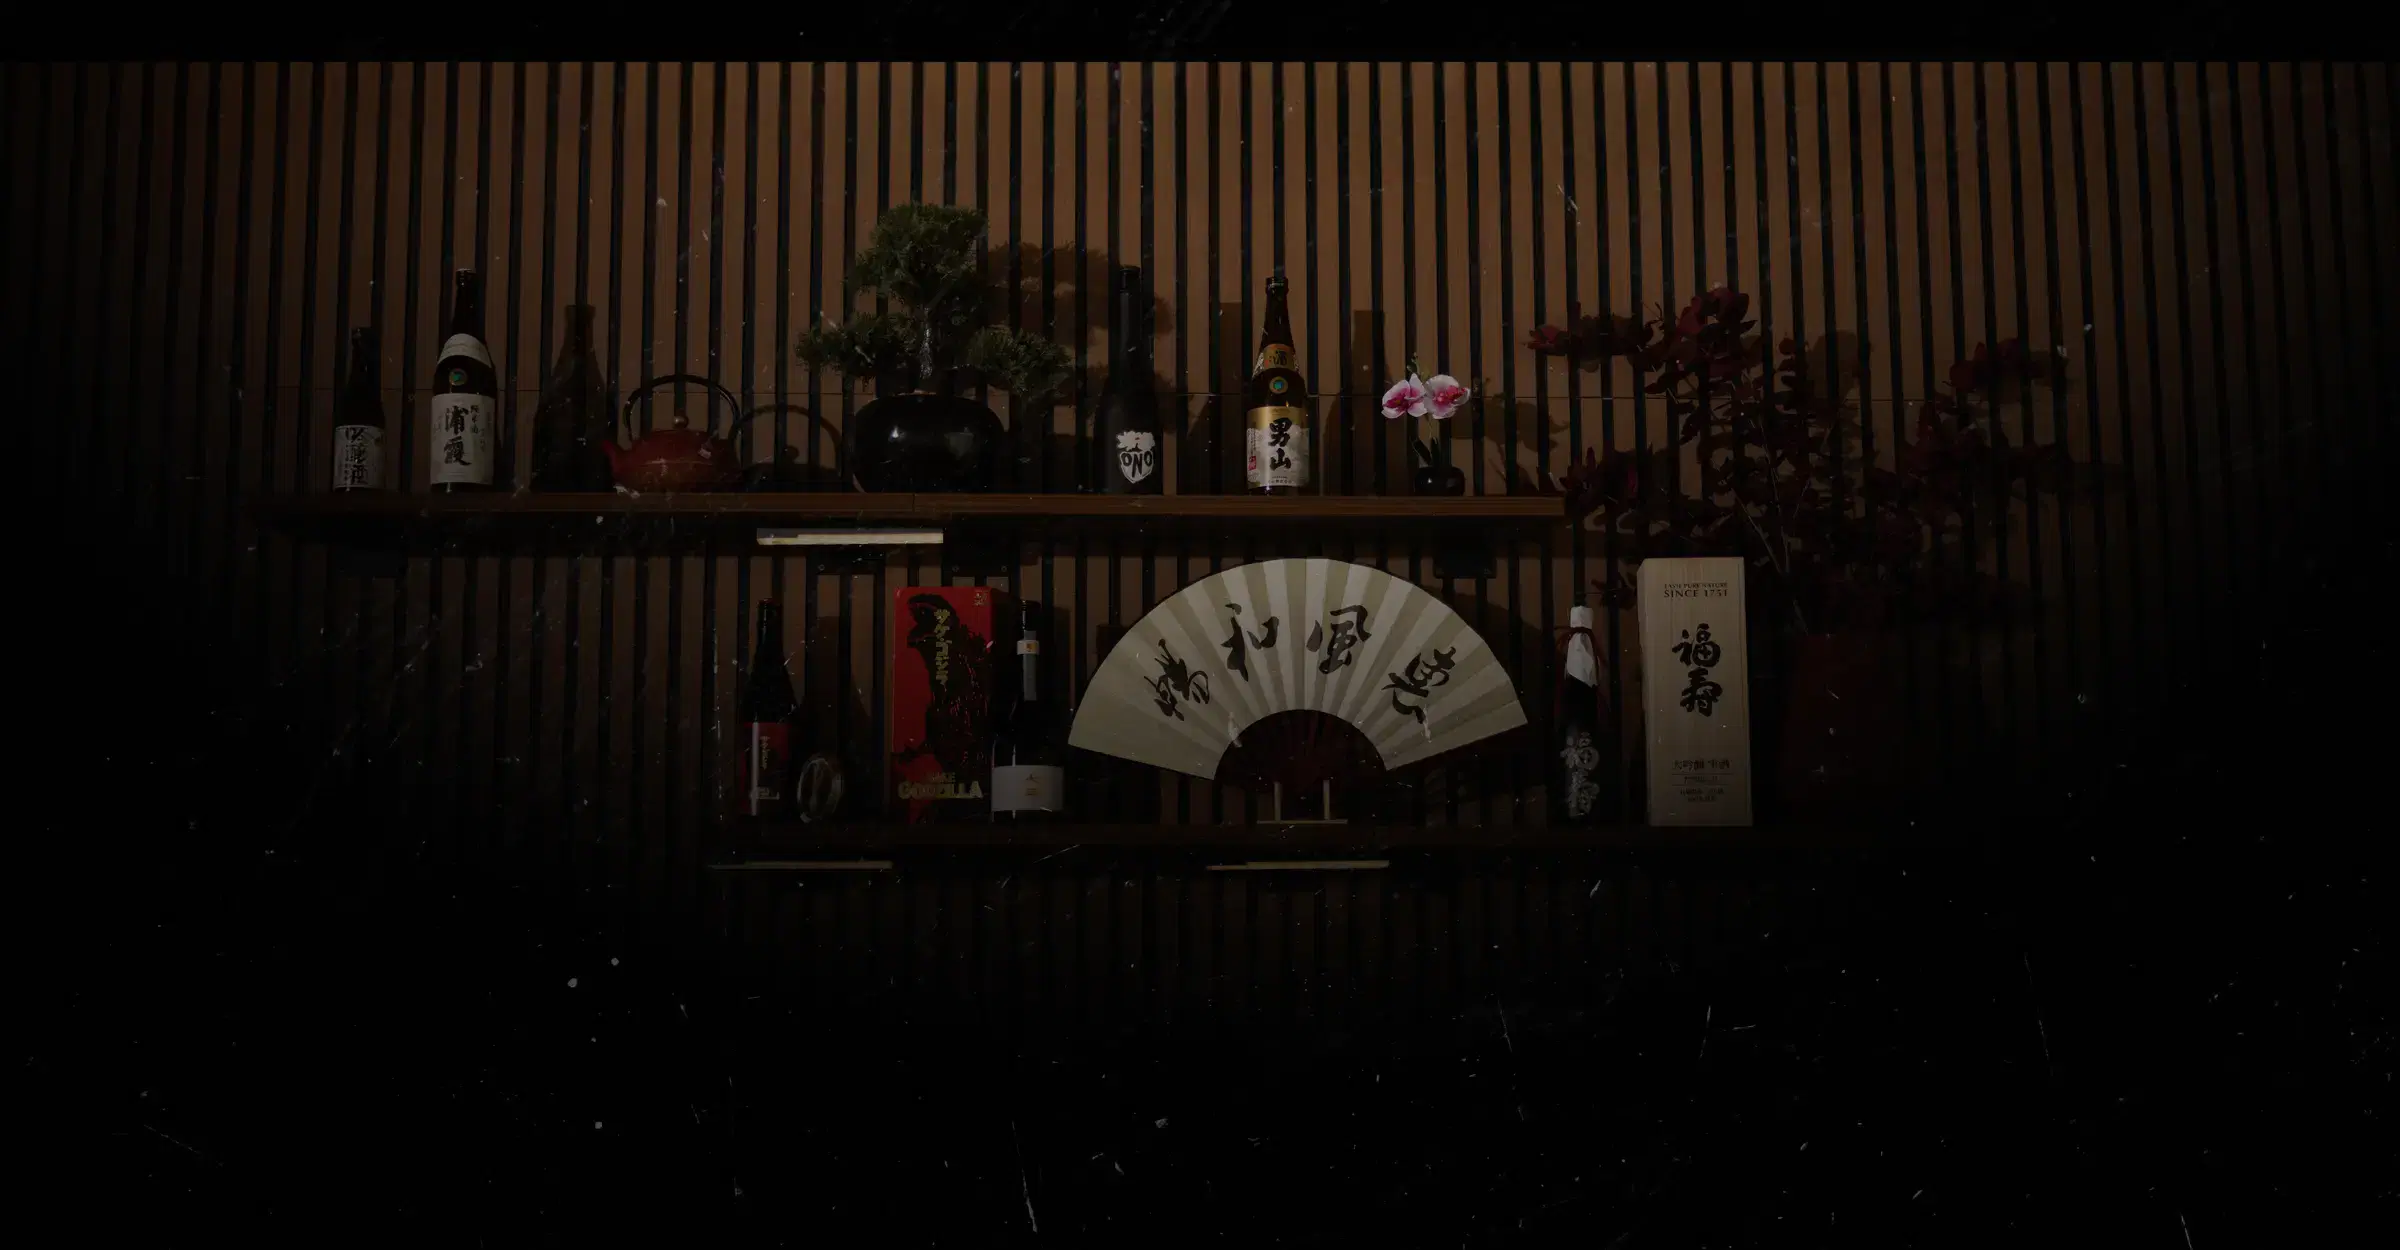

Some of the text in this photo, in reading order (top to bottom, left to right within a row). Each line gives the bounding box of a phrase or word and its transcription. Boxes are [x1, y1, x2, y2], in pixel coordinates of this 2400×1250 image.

[1268, 417, 1292, 471] 男山
[1664, 589, 1729, 598] SINCE 1751
